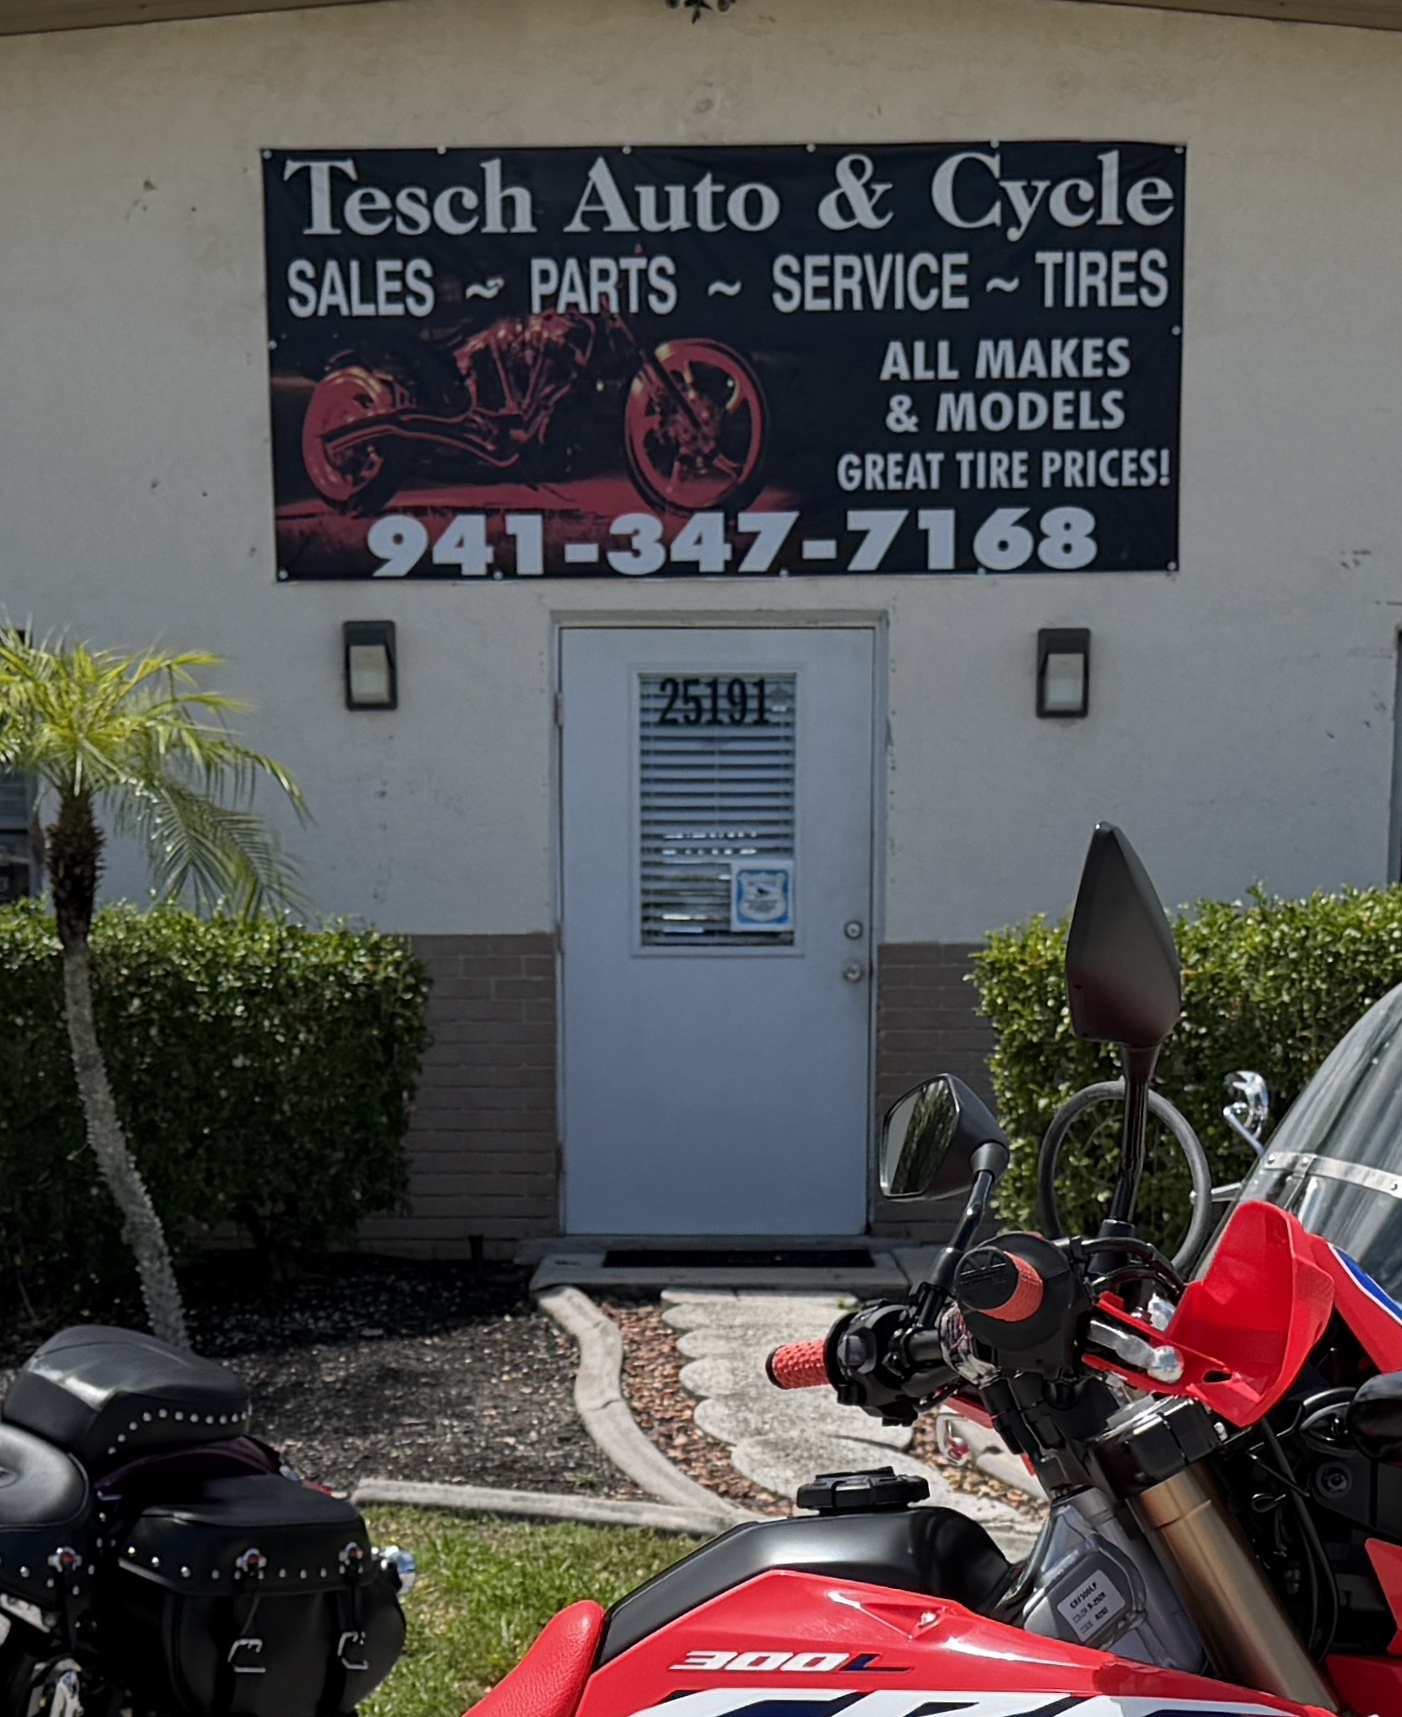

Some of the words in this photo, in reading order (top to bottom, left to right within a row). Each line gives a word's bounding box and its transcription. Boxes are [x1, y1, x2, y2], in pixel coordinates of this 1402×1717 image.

[283, 157, 537, 236] Tesch
[564, 157, 780, 234] Auto
[817, 153, 894, 230] &
[931, 151, 1175, 241] Cycle
[287, 257, 435, 317] SALES
[530, 255, 677, 314] PARTS
[772, 251, 969, 312] SERVICE
[1035, 249, 1169, 308] TIRES
[880, 340, 959, 381] ALL
[974, 337, 1131, 379] MAKES
[885, 395, 919, 434] &
[936, 391, 1125, 431] MODELS
[836, 452, 942, 492] GREAT
[956, 451, 1026, 490] TIRE
[1041, 449, 1171, 490] PRICES!
[366, 506, 1099, 579] 941-347-7168
[658, 677, 770, 726] 25191
[668, 1650, 915, 1672] 300L
